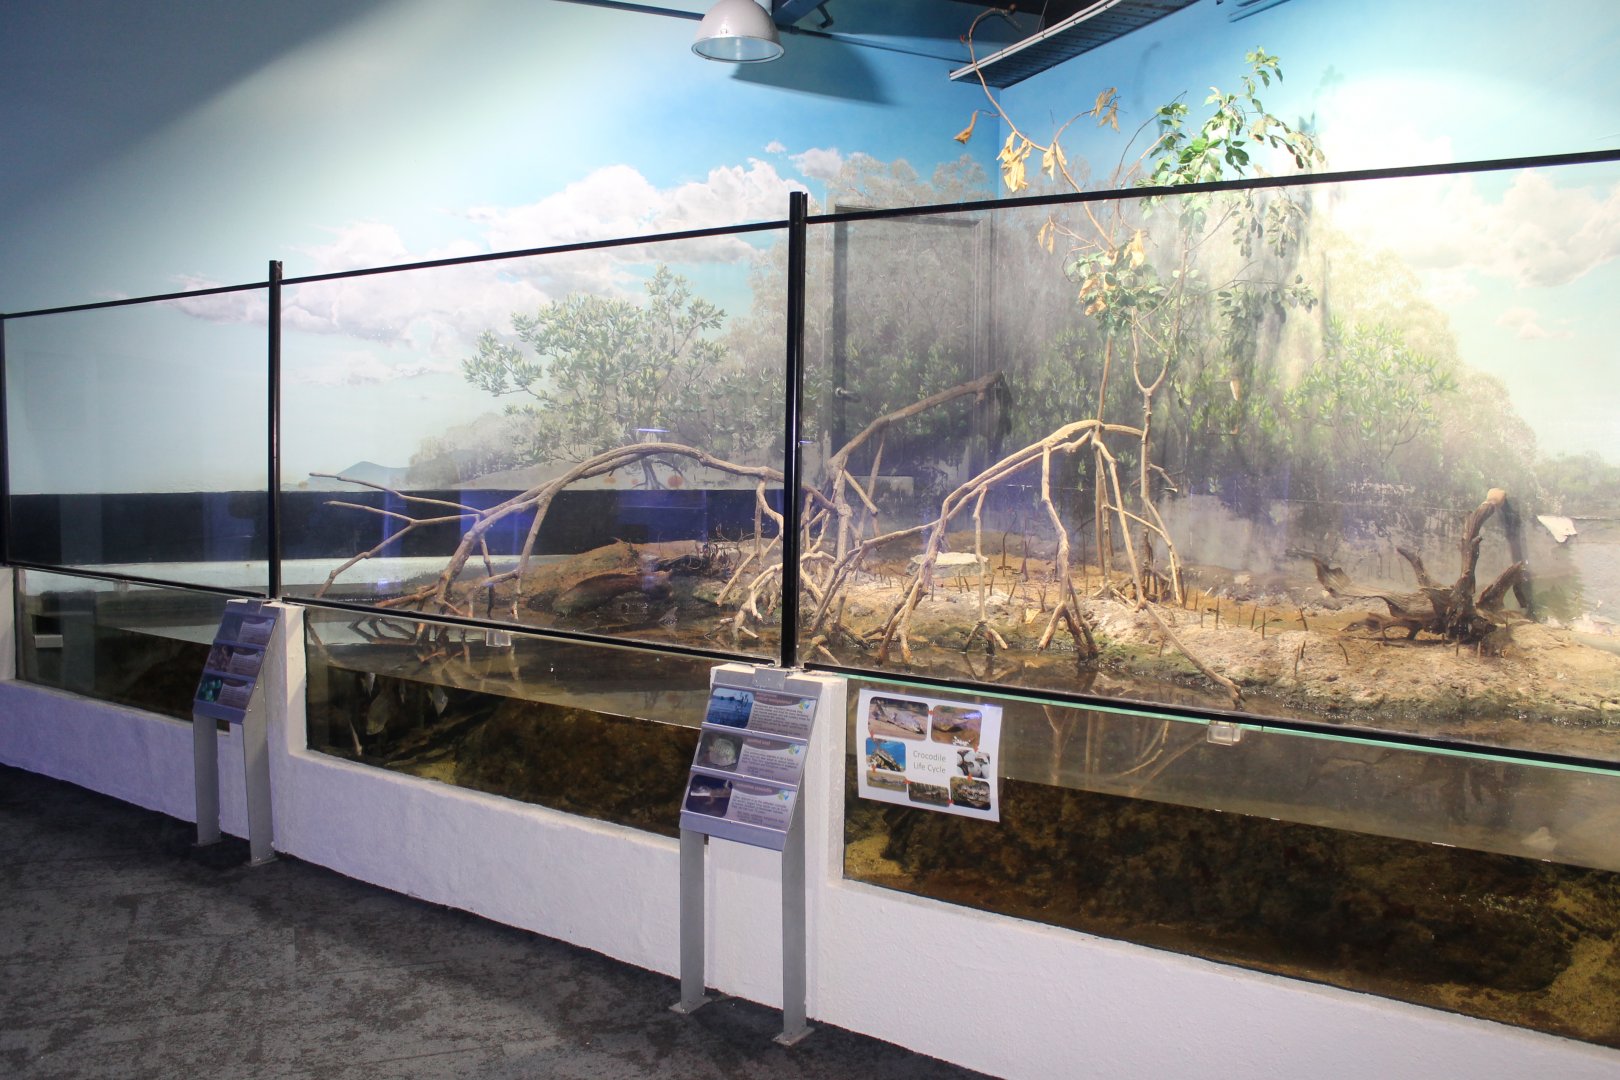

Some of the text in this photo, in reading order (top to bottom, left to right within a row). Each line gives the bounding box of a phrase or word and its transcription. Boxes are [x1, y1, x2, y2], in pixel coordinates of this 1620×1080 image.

[912, 750, 947, 762] Crocodile
[913, 761, 946, 774] Life Cycle
